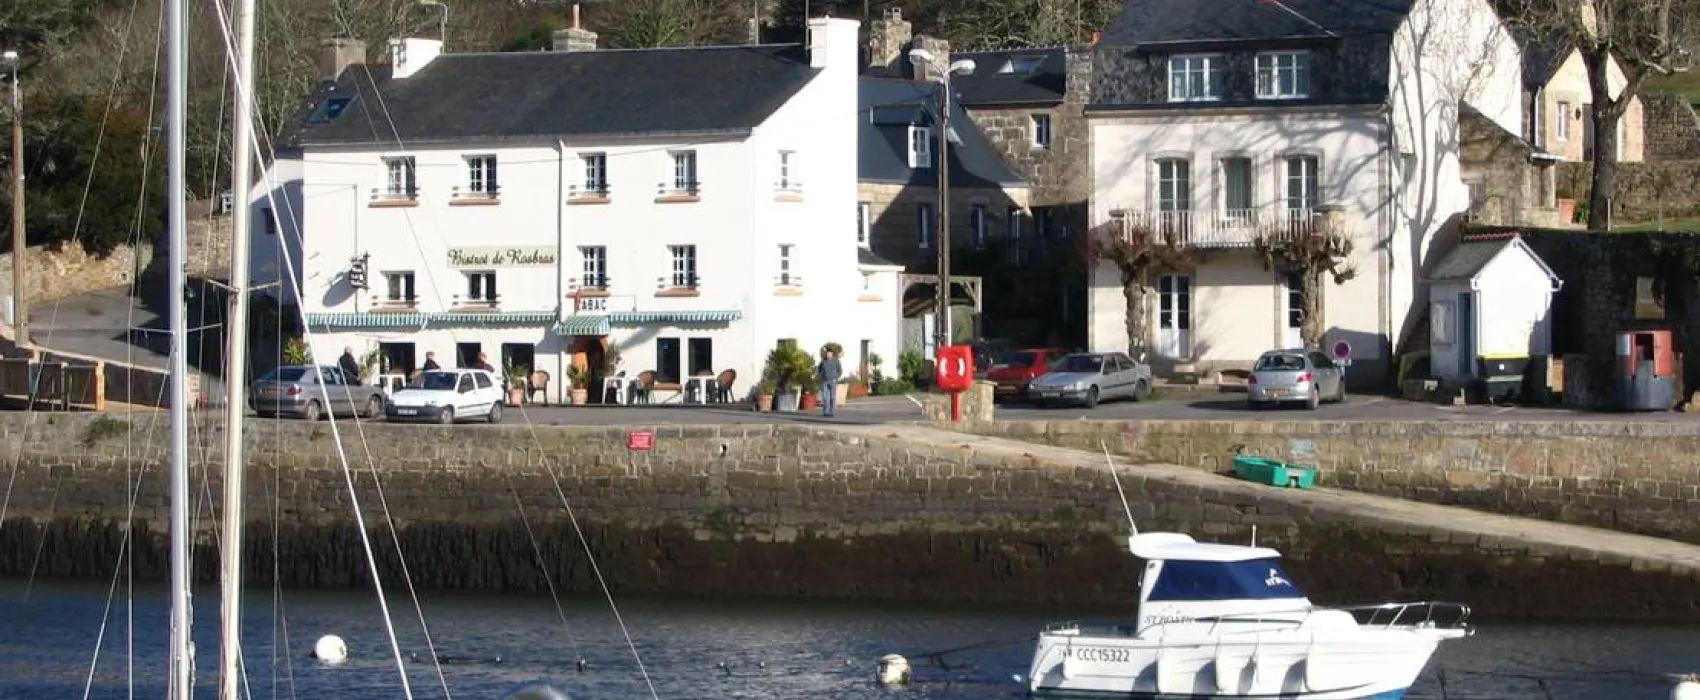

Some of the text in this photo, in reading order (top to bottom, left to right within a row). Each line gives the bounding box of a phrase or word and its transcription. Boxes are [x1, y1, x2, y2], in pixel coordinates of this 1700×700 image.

[447, 249, 555, 265] Bistrot de Rosbras
[1077, 648, 1130, 662] CCC15322
